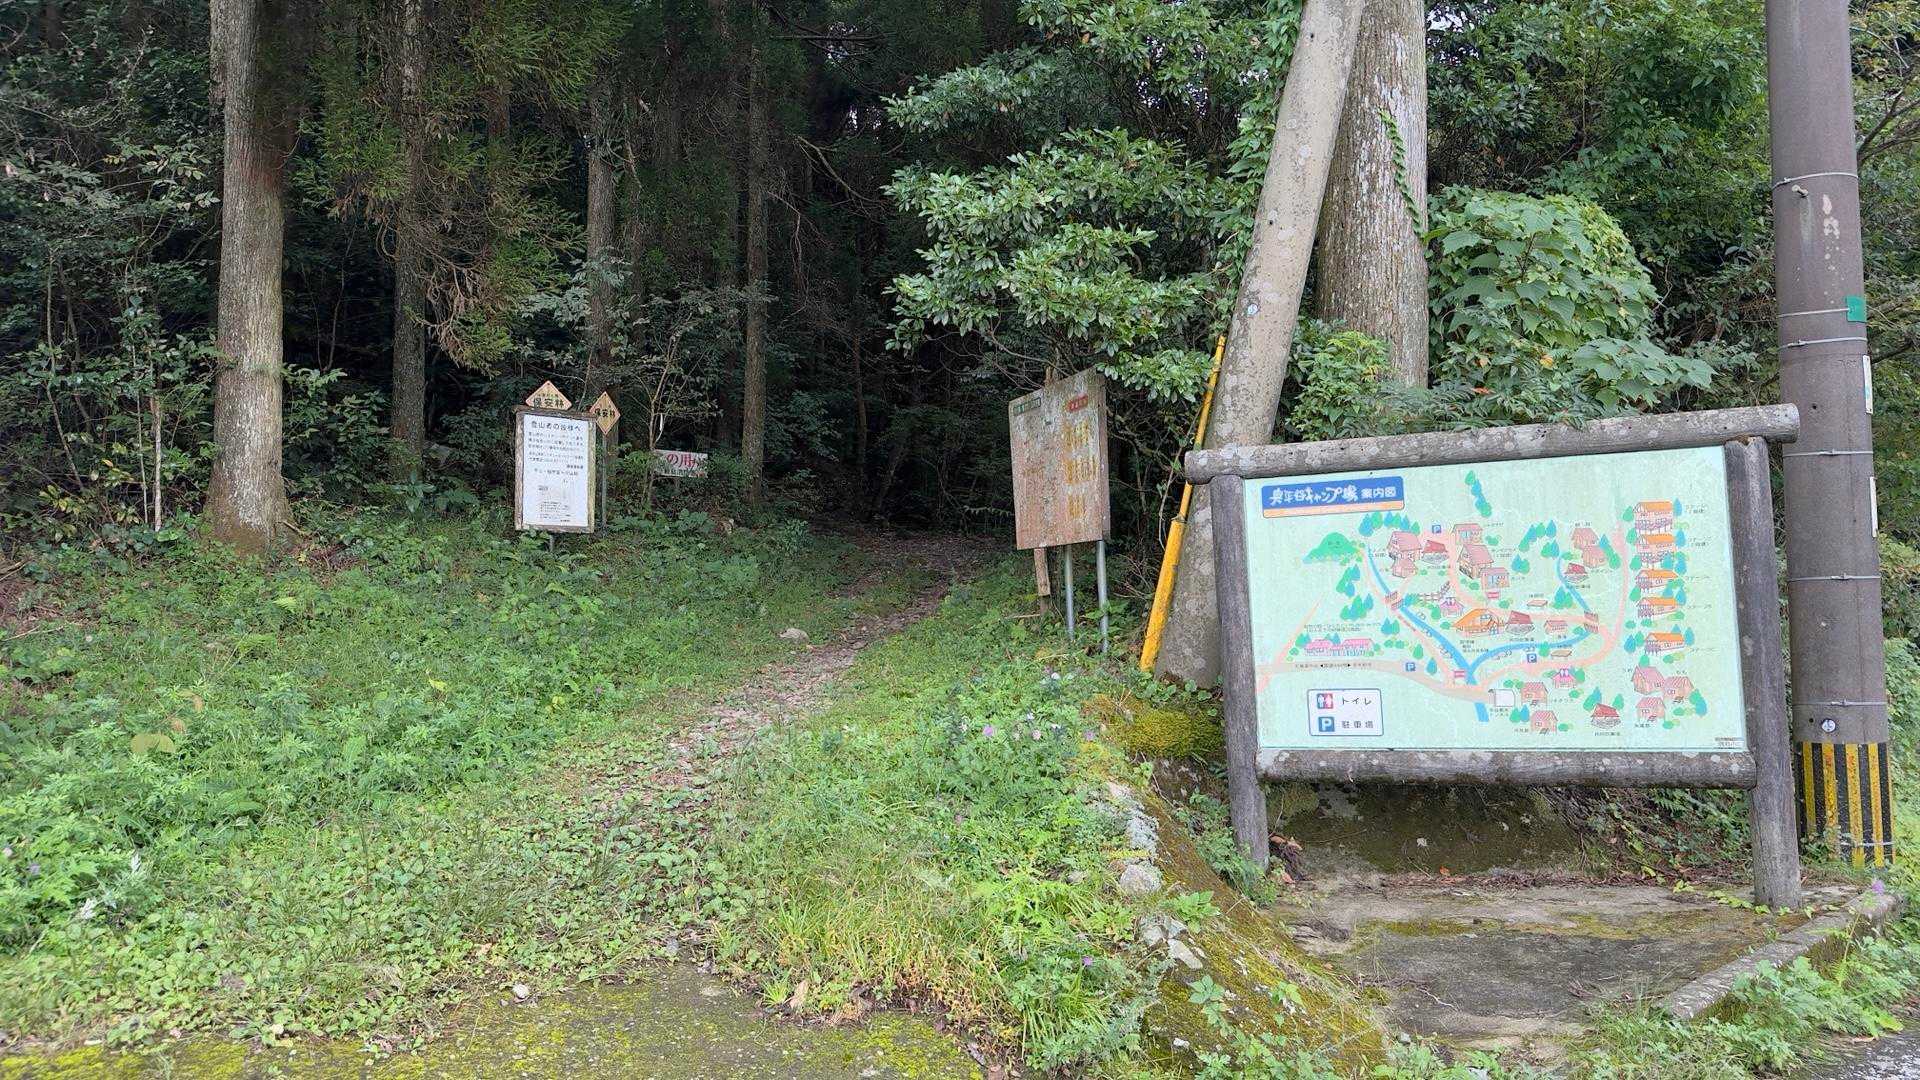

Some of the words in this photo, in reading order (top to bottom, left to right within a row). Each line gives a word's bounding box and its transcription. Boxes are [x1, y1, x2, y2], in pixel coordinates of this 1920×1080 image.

[533, 397, 564, 407] 保安林
[594, 408, 615, 418] 保安林
[1342, 696, 1372, 705] トイレ
[1341, 720, 1374, 729] 駐車場
